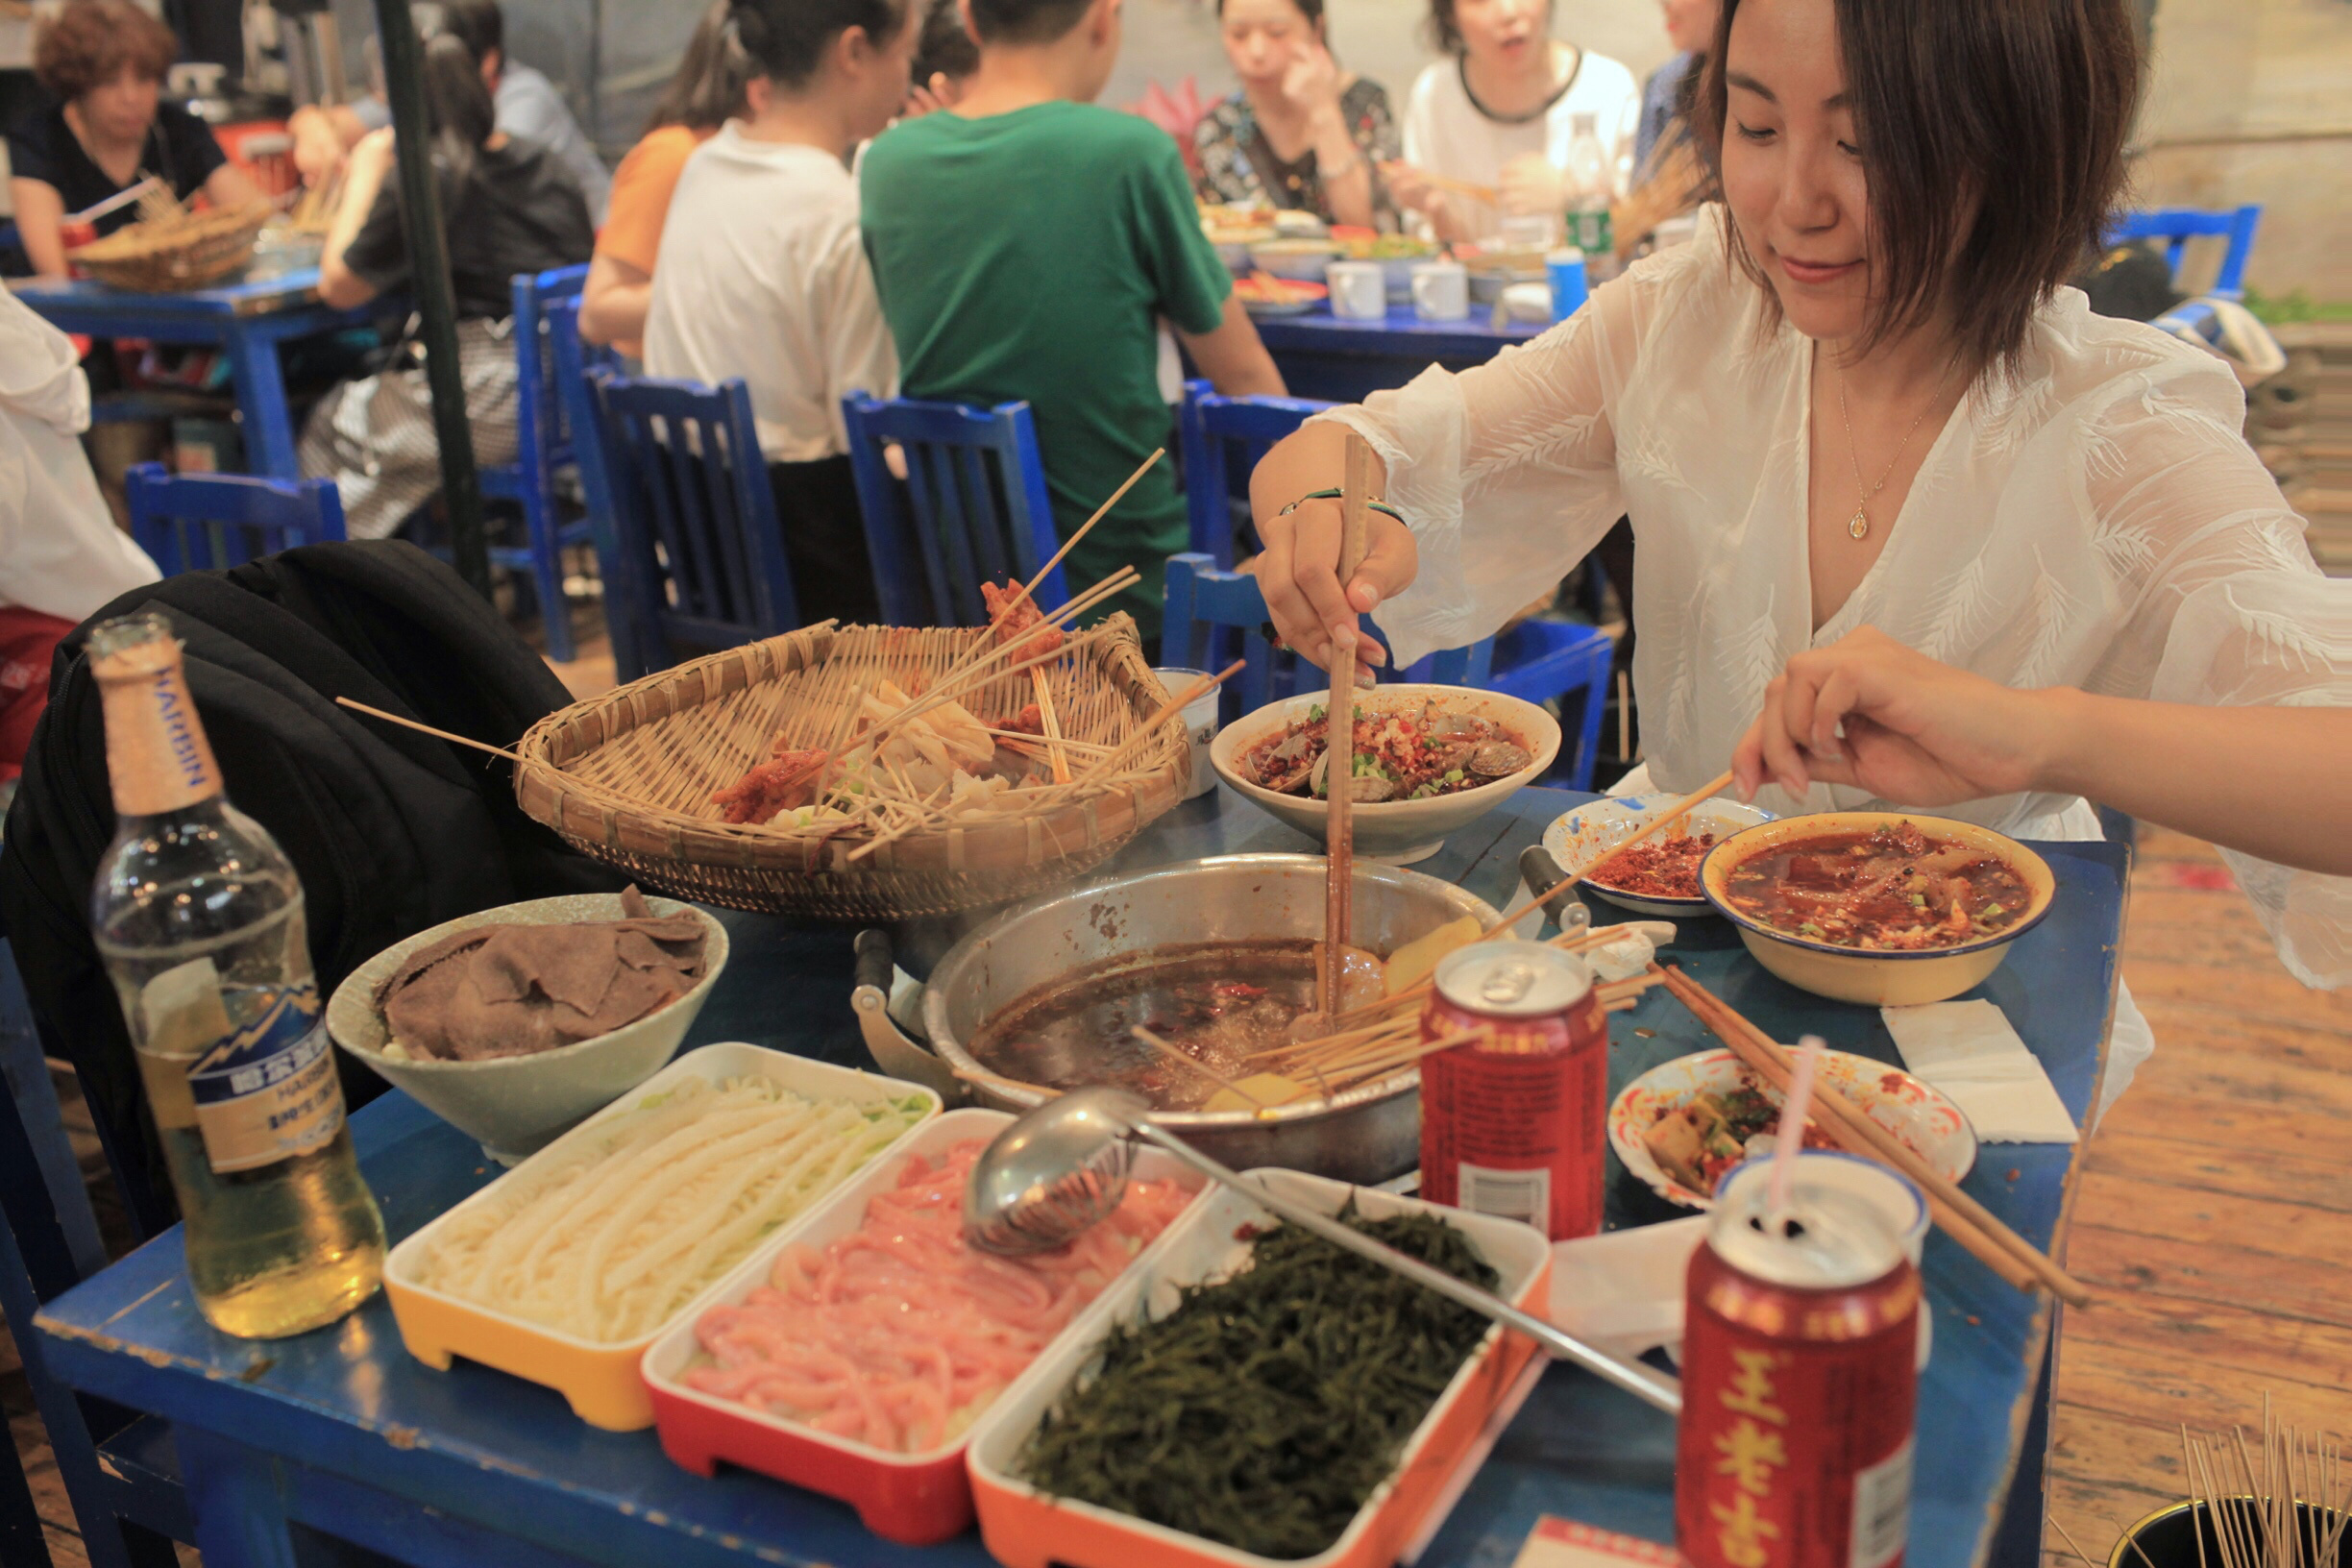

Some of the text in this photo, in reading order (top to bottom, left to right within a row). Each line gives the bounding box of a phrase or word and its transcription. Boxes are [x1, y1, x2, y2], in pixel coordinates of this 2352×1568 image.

[156, 666, 208, 788] HARBIN
[1709, 1348, 1789, 1567] 王老吉
